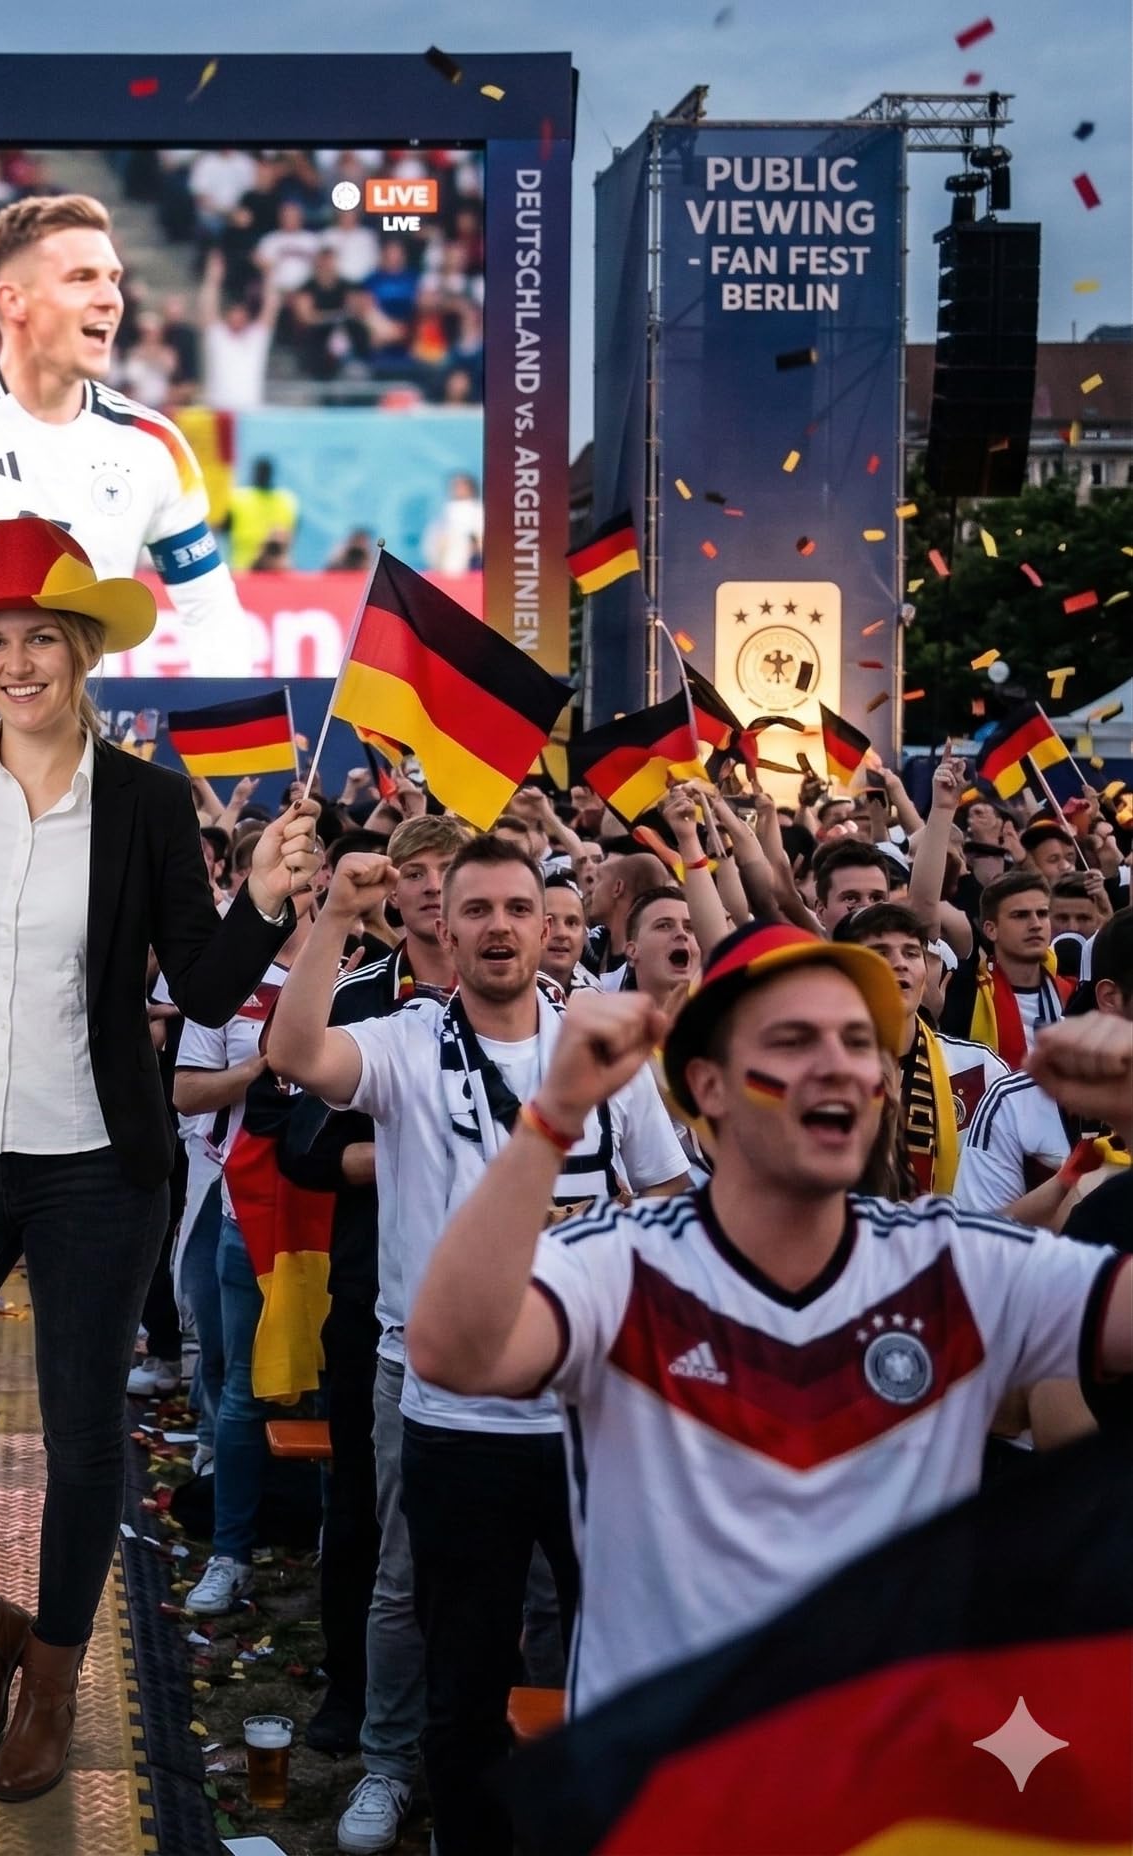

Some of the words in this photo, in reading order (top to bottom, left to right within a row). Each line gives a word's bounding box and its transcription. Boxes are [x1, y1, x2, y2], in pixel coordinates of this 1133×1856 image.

[706, 156, 858, 192] PUBLIC
[373, 185, 429, 207] LIVE
[382, 215, 421, 232] LIVE
[685, 199, 876, 236] VIEWING
[710, 246, 777, 275] FAN
[789, 246, 871, 276] FEST
[514, 169, 542, 394] DEUTSCHLAND
[722, 283, 839, 311] BERLIN
[514, 401, 534, 438] vs.
[513, 445, 541, 652] ARGENTINIEN
